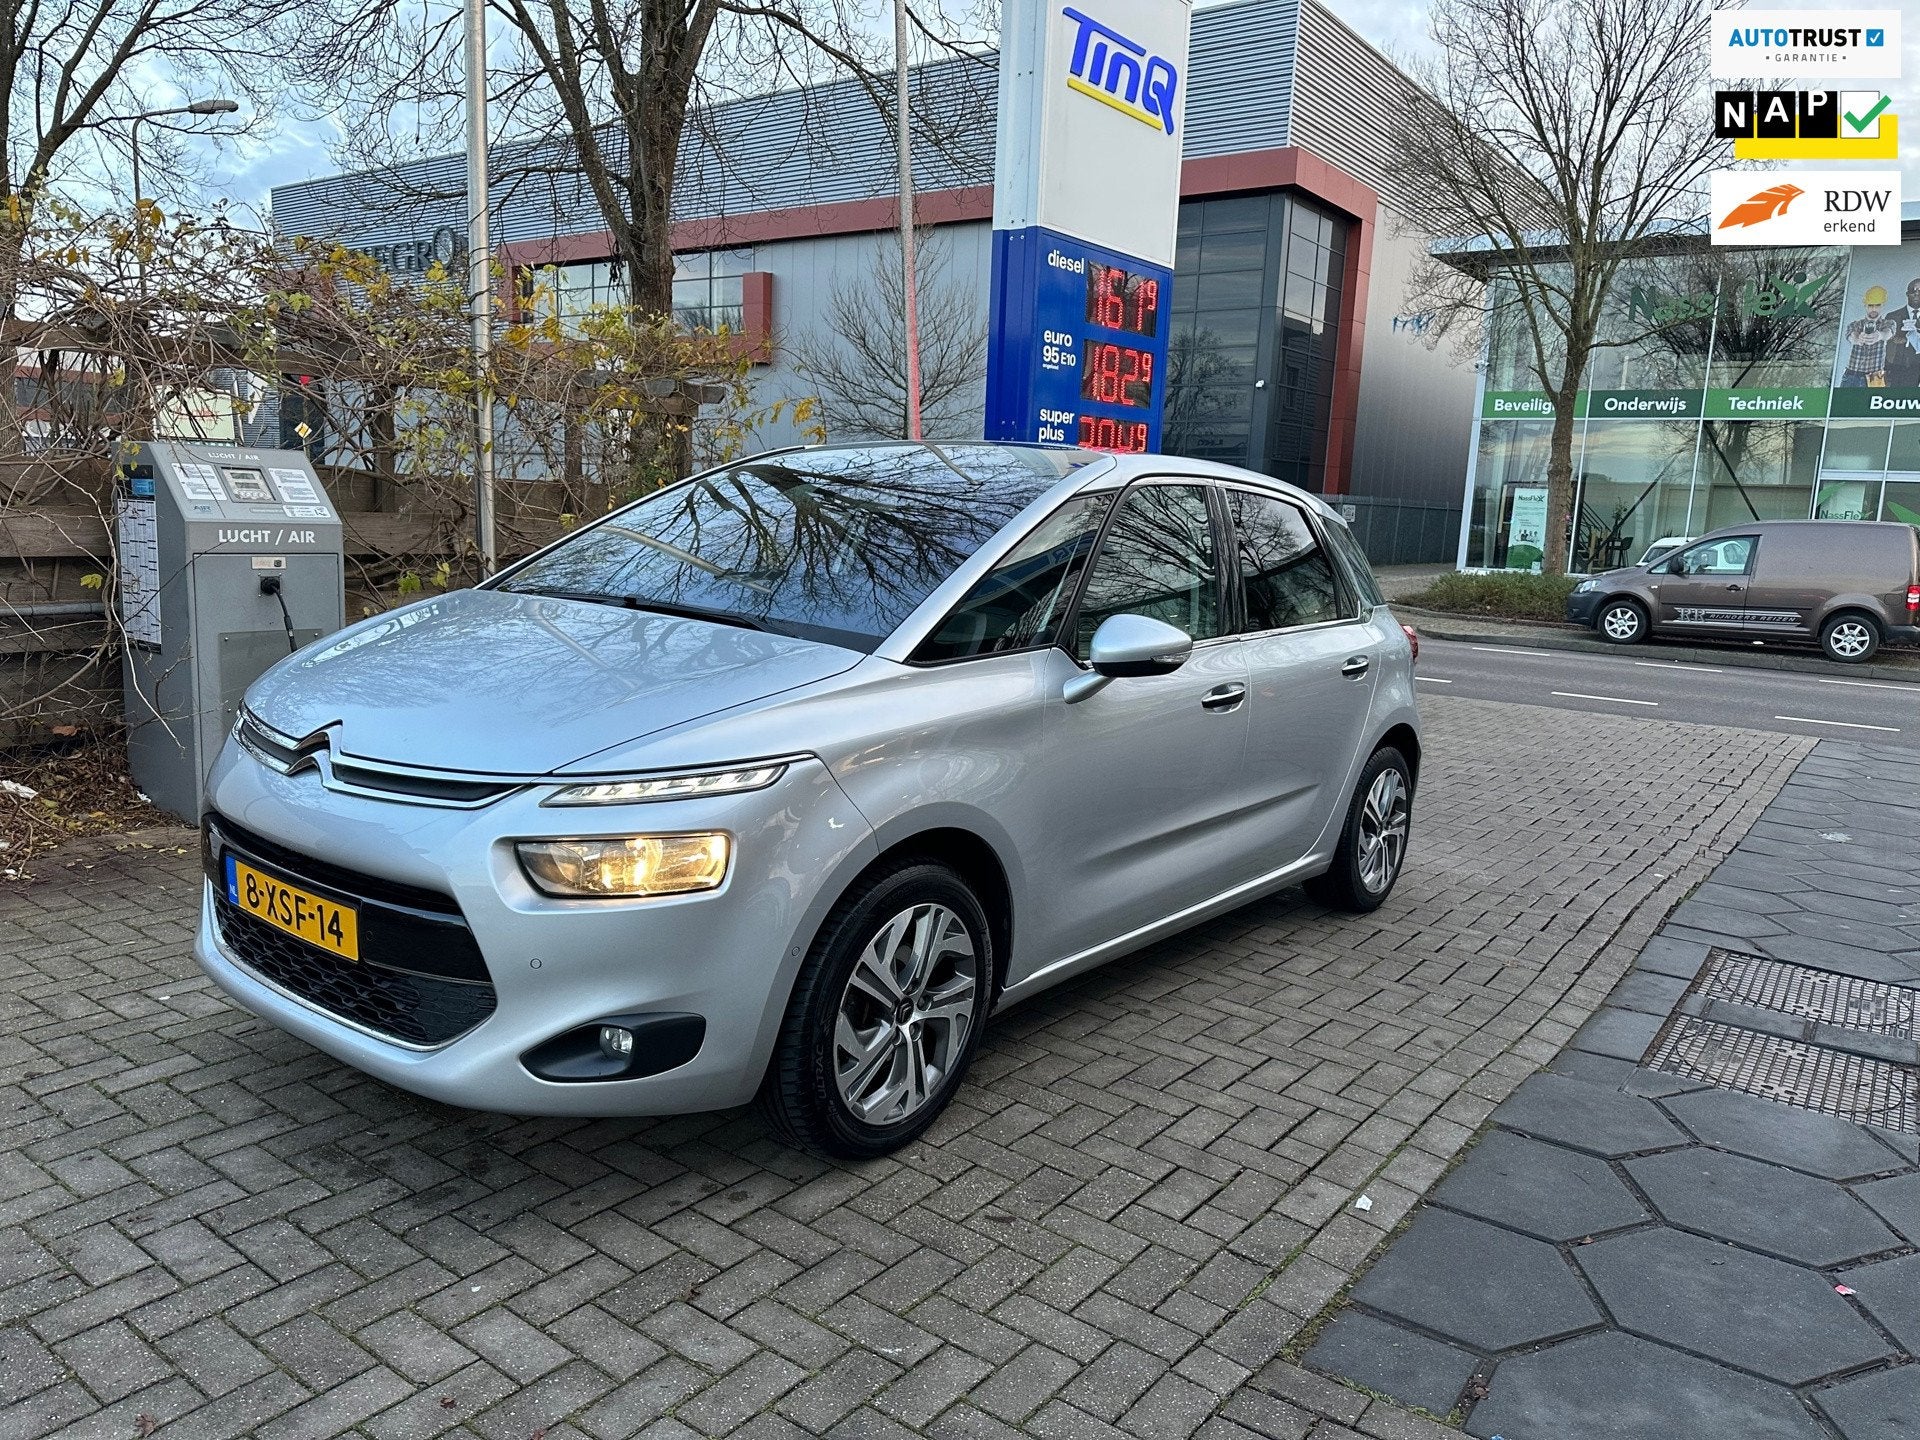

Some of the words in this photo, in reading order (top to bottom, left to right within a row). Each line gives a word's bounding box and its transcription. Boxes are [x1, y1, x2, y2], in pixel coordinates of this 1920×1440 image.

[1063, 7, 1177, 135] TinQ
[1048, 249, 1085, 274] diesel
[1043, 330, 1073, 347] euro
[1043, 345, 1060, 364] 95
[1060, 352, 1077, 366] E10
[1494, 399, 1556, 414] Beveilig
[1604, 397, 1687, 414] Onderwijs
[1728, 396, 1804, 411] Techniek
[1869, 395, 1920, 410] Bouw
[1040, 408, 1075, 426] super
[1038, 423, 1064, 443] plus
[218, 529, 271, 544] LUCHT
[275, 529, 284, 546] /
[288, 530, 316, 543] AIR
[246, 873, 344, 947] 8-XSF-14
